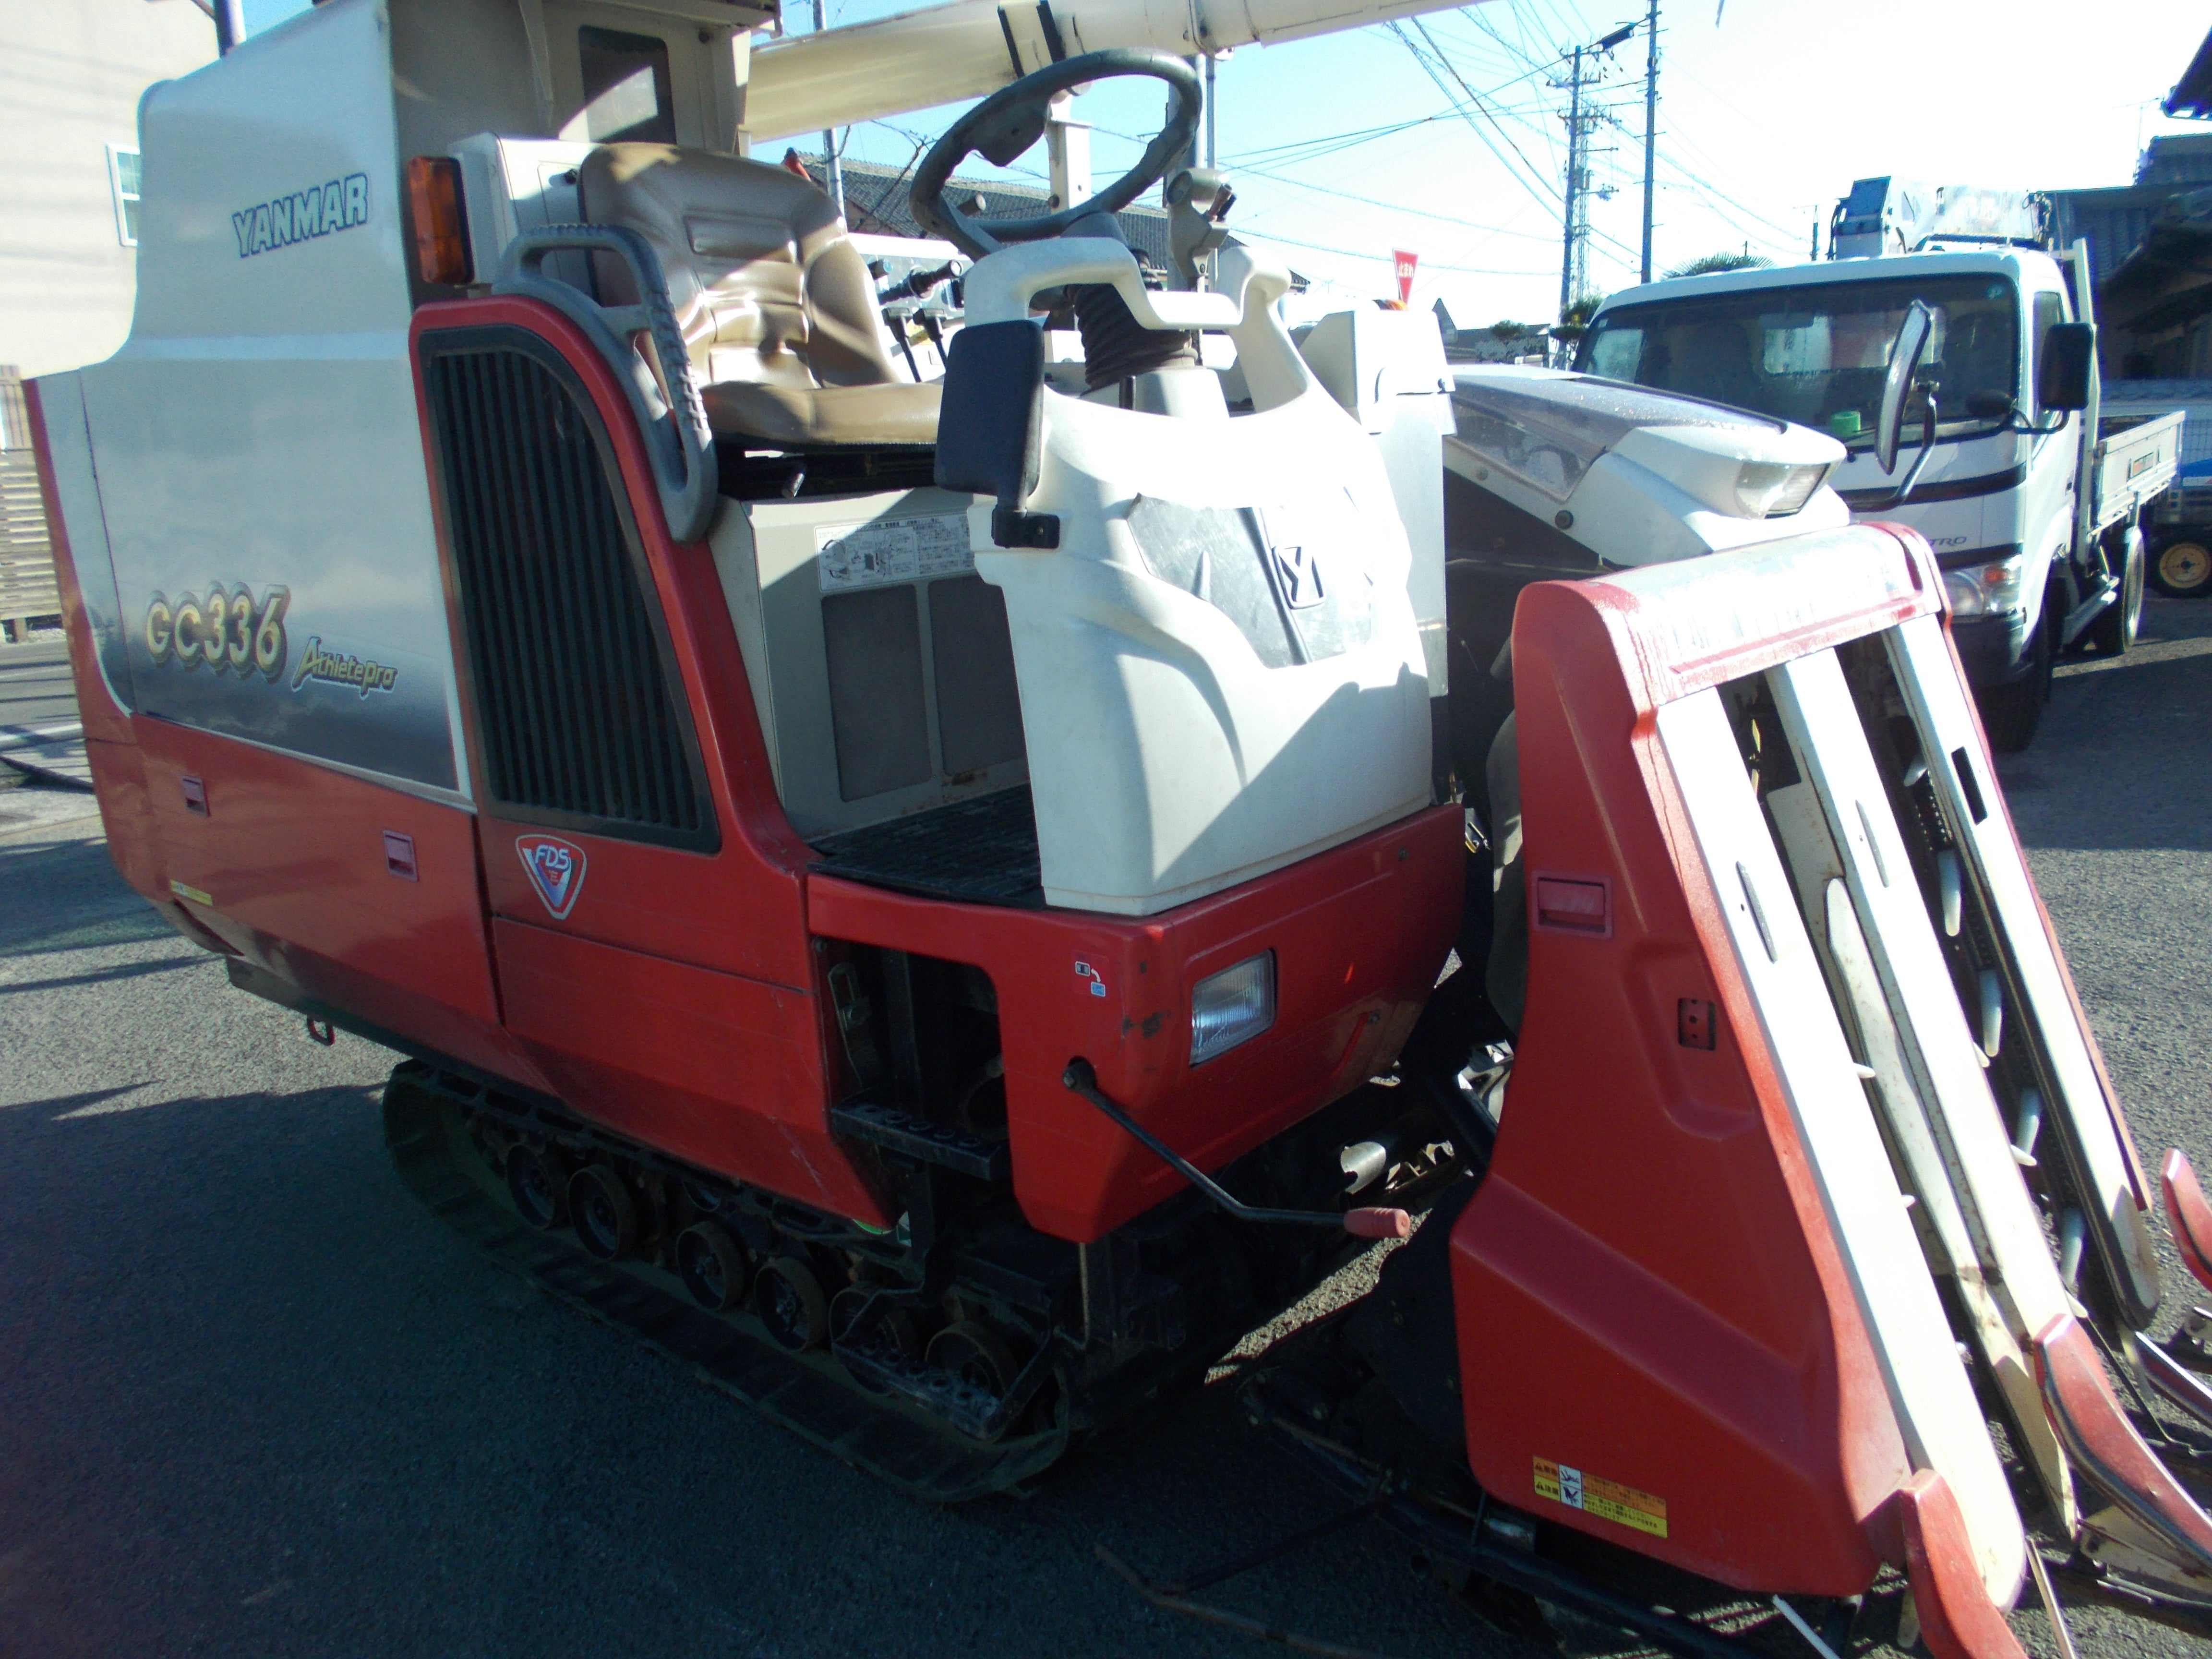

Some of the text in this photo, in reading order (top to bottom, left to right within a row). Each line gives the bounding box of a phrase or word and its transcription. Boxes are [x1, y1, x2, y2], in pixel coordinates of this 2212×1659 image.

[232, 173, 369, 259] YANMAR
[1398, 262, 1414, 278] 止まれ
[1926, 536, 1968, 547] TRO
[145, 588, 287, 678] GC336
[535, 844, 570, 870] FDS
